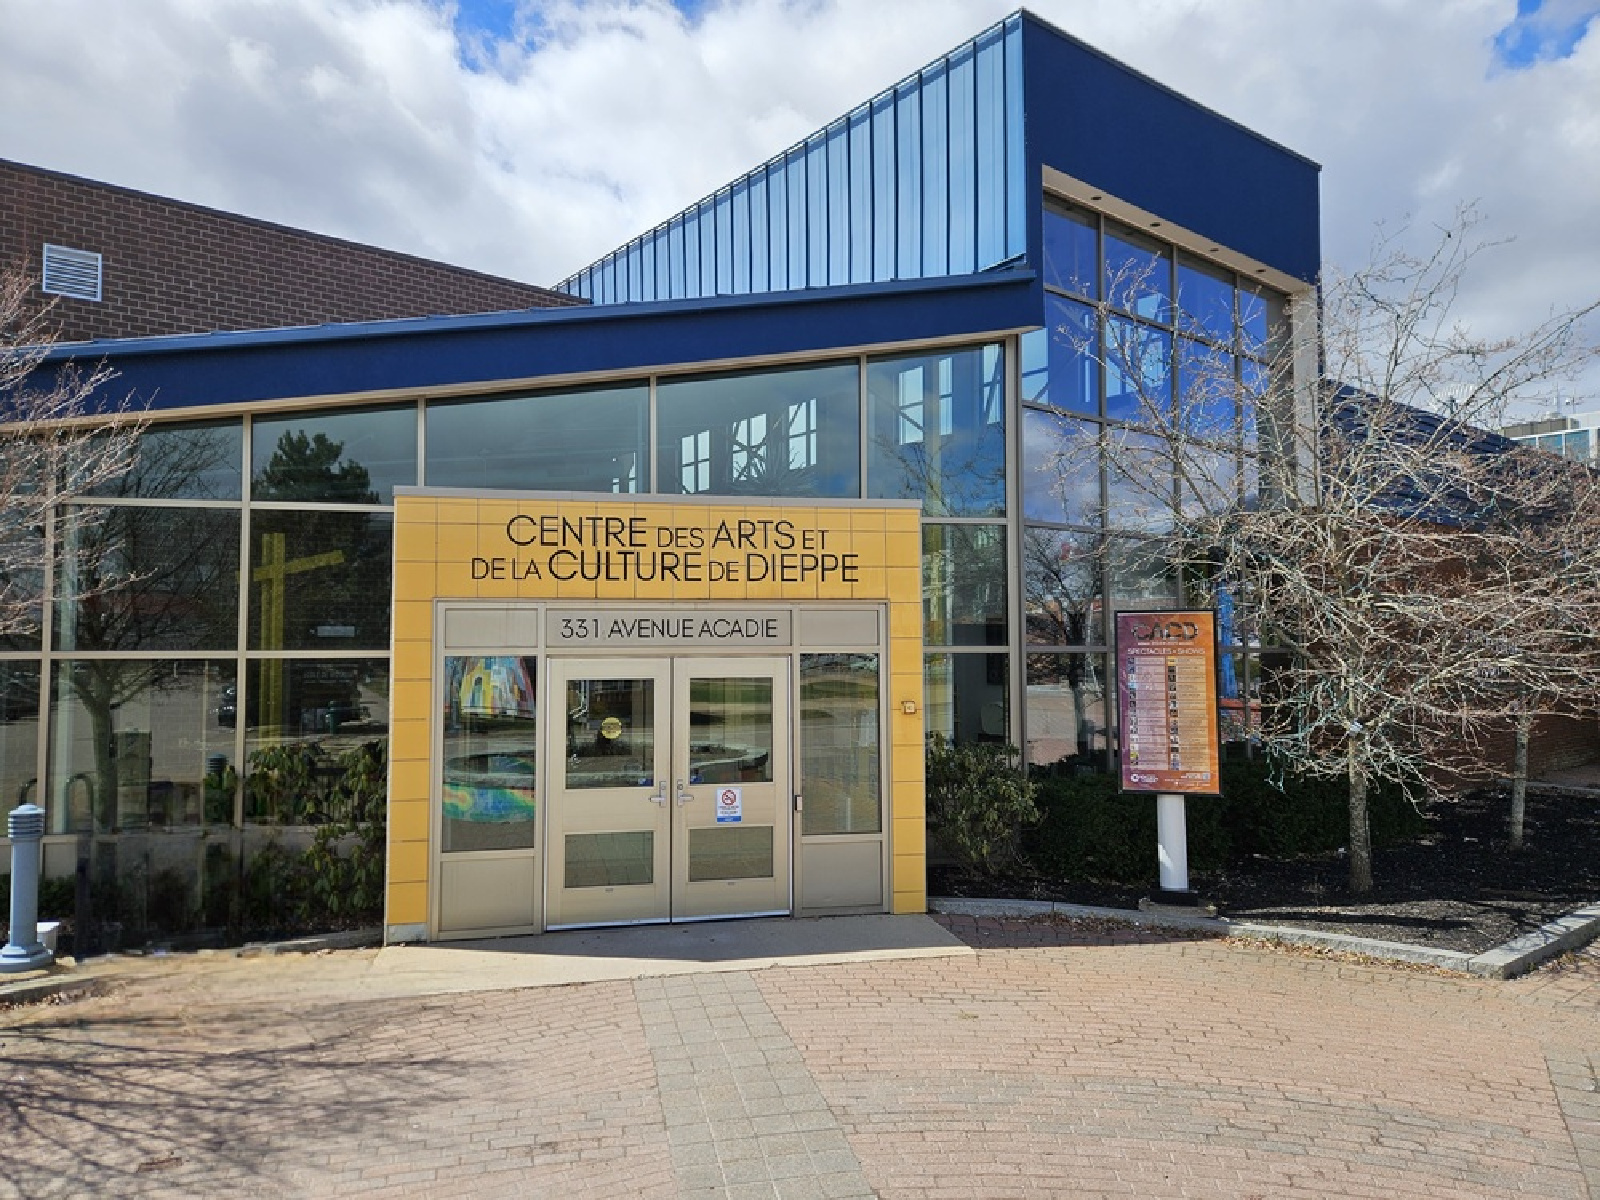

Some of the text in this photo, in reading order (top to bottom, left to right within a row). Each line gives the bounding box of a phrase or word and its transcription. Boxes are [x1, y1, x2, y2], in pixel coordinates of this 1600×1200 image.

[506, 514, 829, 550] CENTRE DES ARTS ET
[471, 550, 859, 583] DE LA CULTURE DE DIEPPE
[560, 618, 778, 639] 331 AVENUE ACADIE
